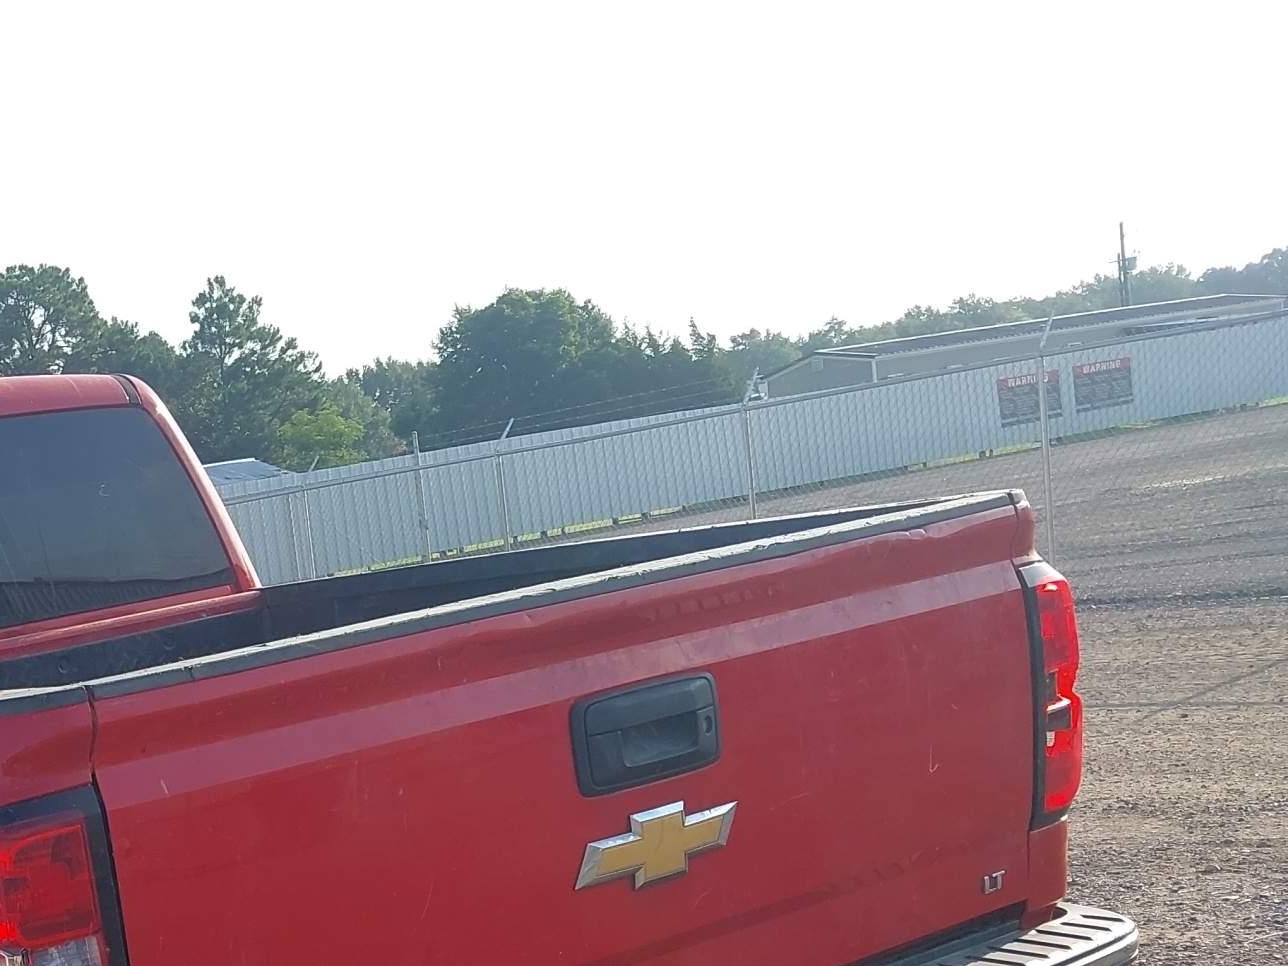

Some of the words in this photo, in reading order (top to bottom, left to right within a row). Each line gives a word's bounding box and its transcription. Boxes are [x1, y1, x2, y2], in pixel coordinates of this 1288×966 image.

[1083, 359, 1121, 374] WARNING
[1007, 373, 1049, 388] WARNIG
[984, 870, 1005, 894] LT
